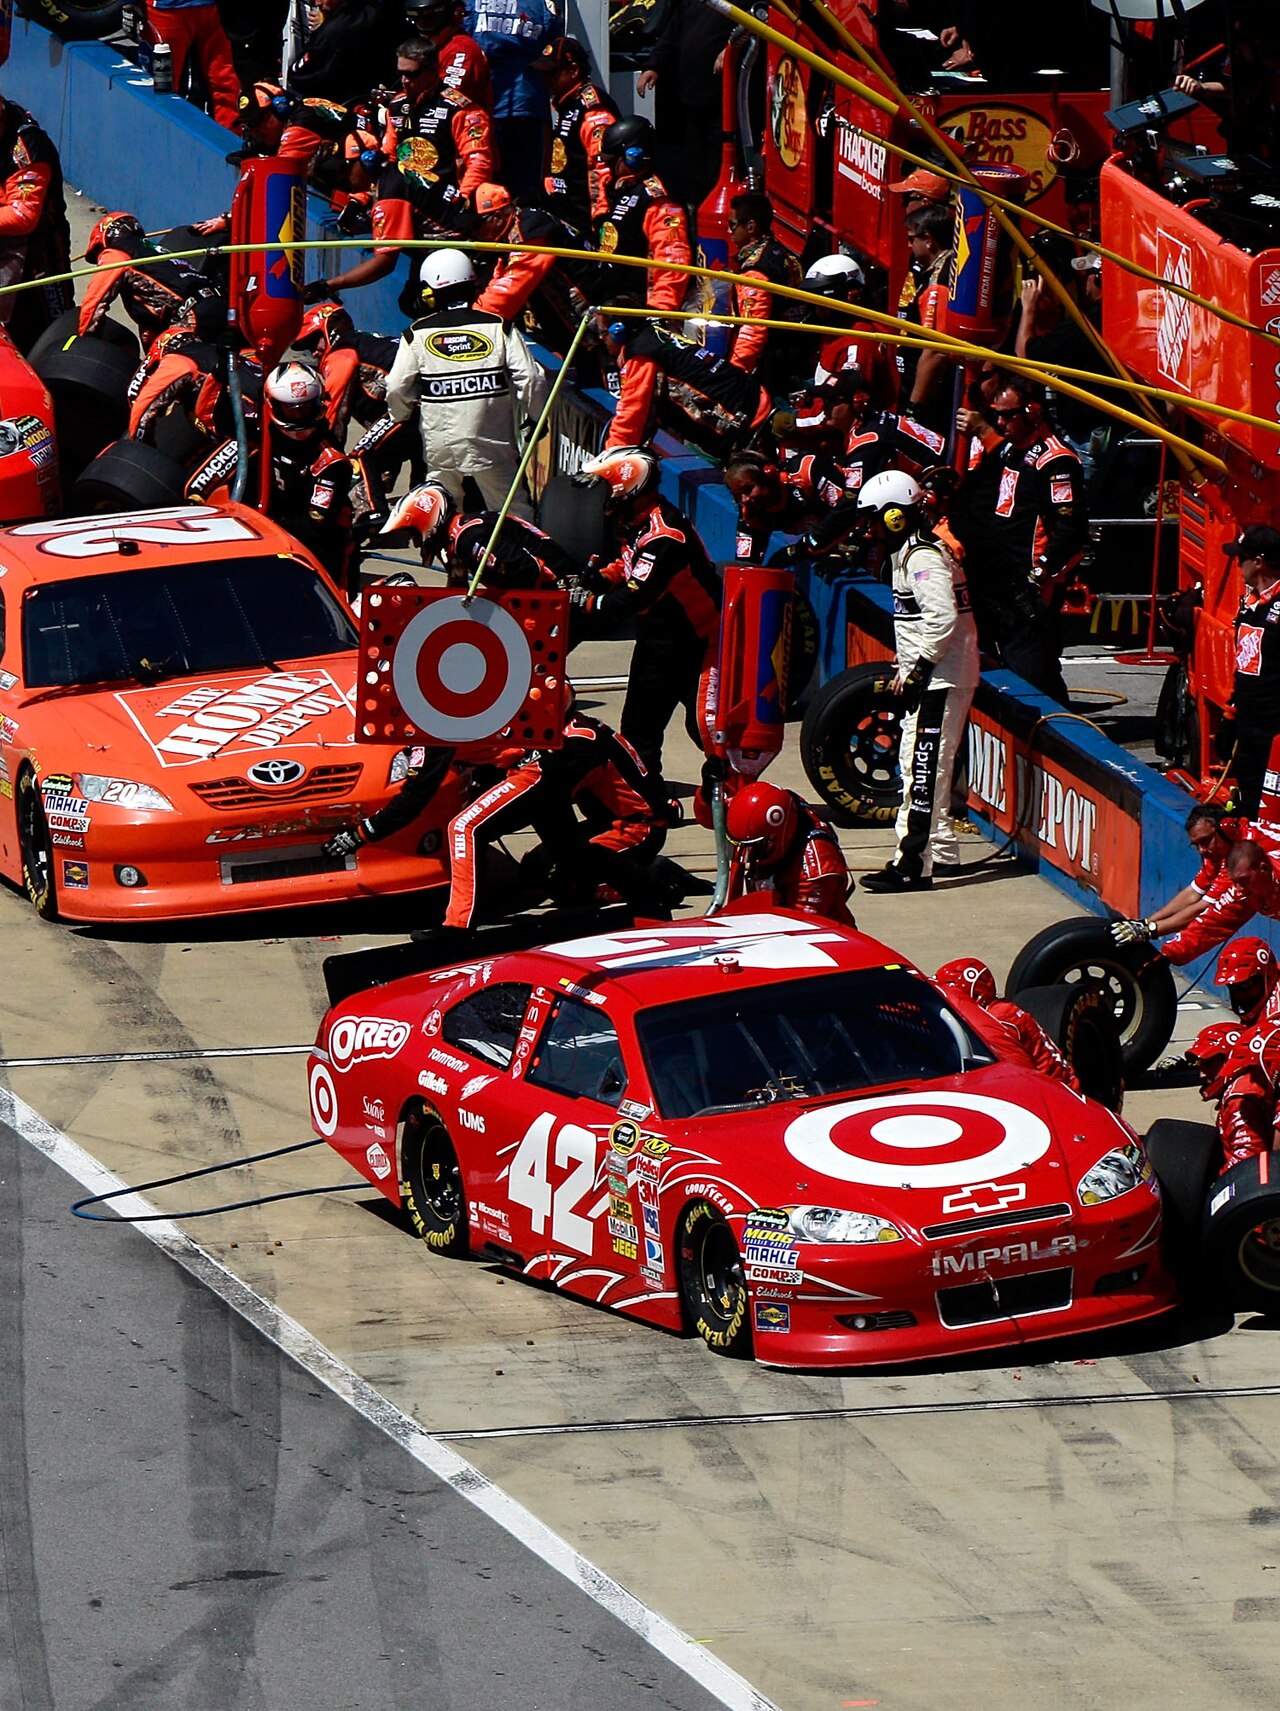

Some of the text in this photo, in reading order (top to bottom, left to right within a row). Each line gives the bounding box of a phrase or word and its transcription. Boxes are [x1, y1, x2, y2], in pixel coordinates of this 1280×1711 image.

[475, 13, 542, 39] America
[967, 112, 1027, 140] Bass
[839, 127, 886, 181] TRACKER
[970, 139, 1014, 164] Pro
[448, 343, 471, 352] Sprint
[430, 376, 501, 395] OFFICIAL
[24, 428, 51, 448] MOOG
[155, 686, 233, 718] THE
[156, 673, 332, 757] HOME
[238, 692, 346, 747] DEPOT
[914, 741, 934, 795] Sprint
[103, 783, 138, 800] 20
[969, 721, 1096, 872] ME DEPOT
[46, 796, 87, 813] MAHLE
[50, 815, 78, 828] COMP
[454, 782, 516, 859] THE HOME DEPOT
[52, 834, 83, 847] Edelbrock
[333, 1021, 406, 1060] OREO
[418, 1070, 449, 1095] Gillette
[363, 1096, 385, 1122] Suave
[458, 1108, 486, 1134] TUMS
[508, 1112, 597, 1256] 42
[640, 1180, 658, 1206] 3M
[685, 1183, 734, 1213] GOODYEAR
[610, 1217, 628, 1235] Mobil
[745, 1228, 794, 1243] MOOG
[747, 1220, 783, 1230] BELTS
[613, 1238, 637, 1260] JEGS
[747, 1246, 797, 1265] MAHLE
[932, 1235, 1077, 1276] IMPALA
[752, 1267, 789, 1280] COMP
[756, 1286, 794, 1299] Edelbrock
